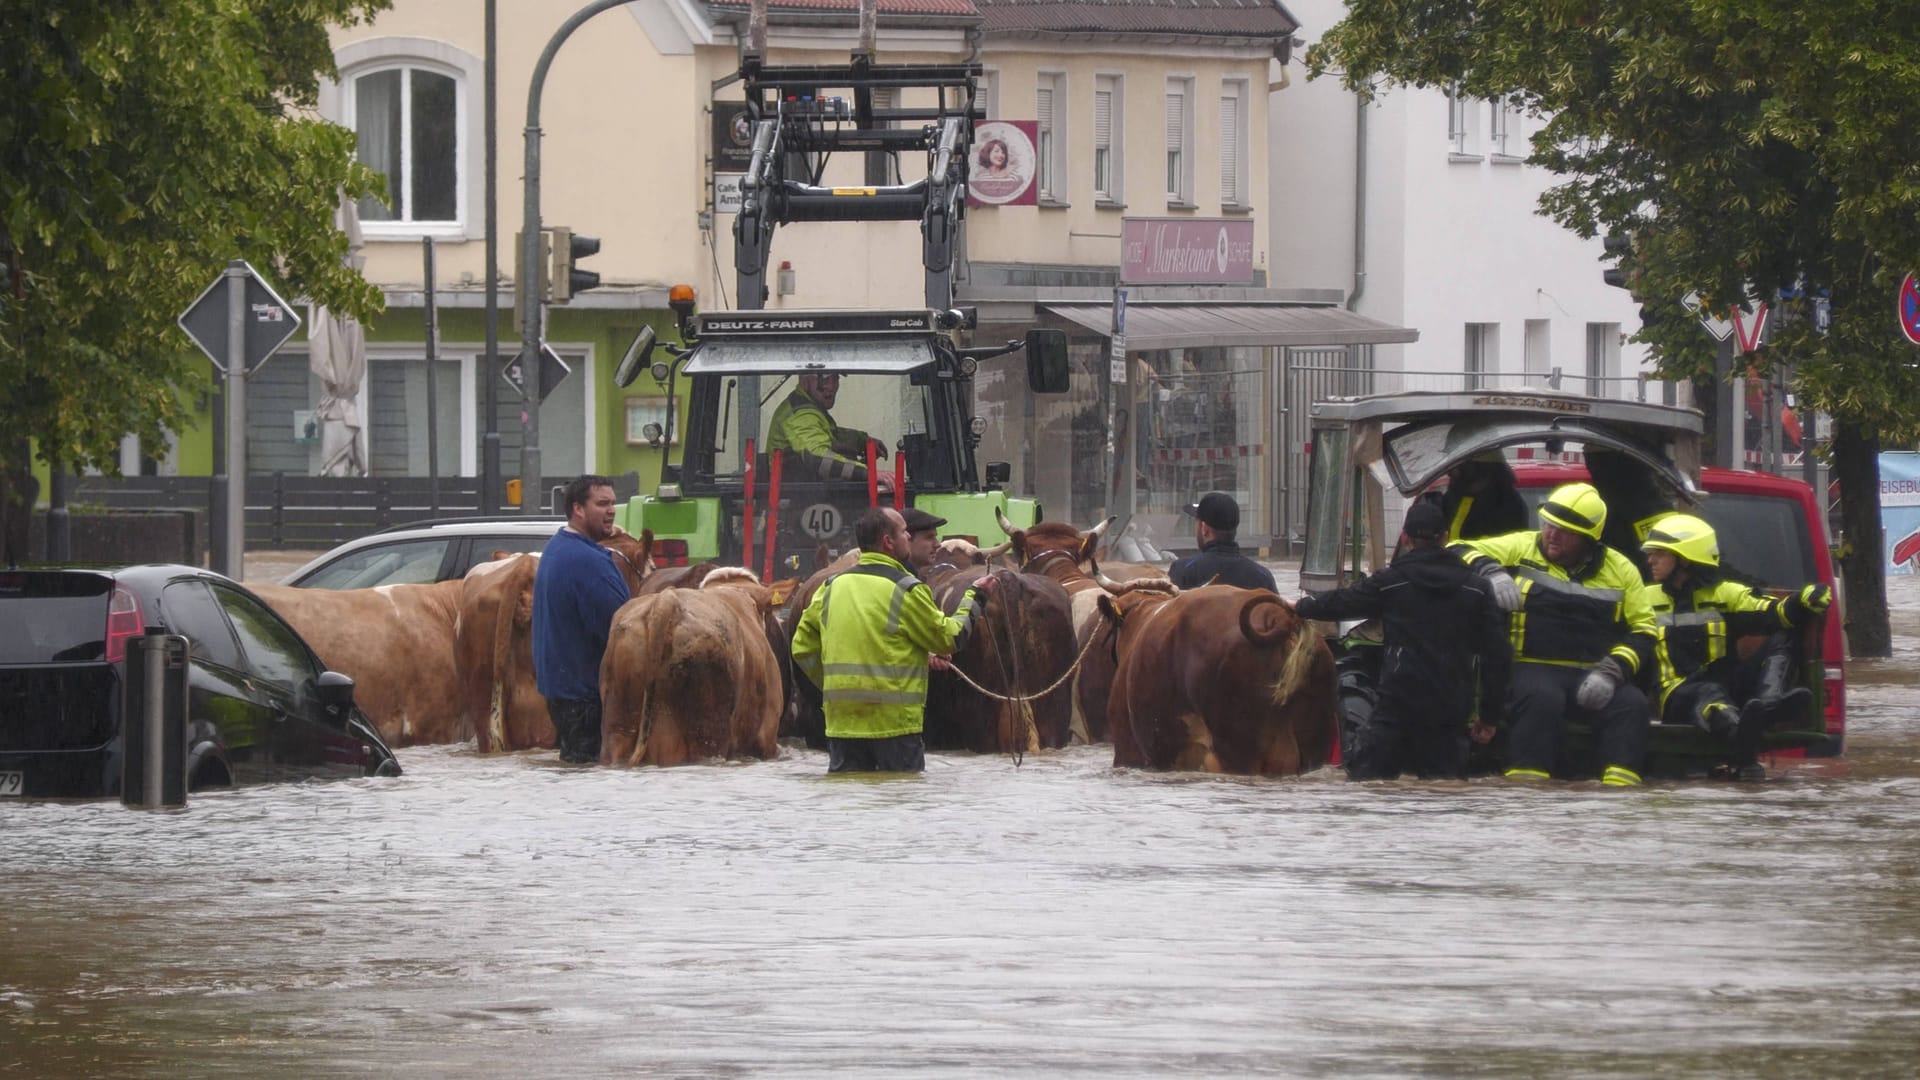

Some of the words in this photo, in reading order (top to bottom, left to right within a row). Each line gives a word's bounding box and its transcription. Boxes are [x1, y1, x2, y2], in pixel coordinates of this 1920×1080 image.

[717, 183, 737, 193] Cafe
[1144, 221, 1215, 273] Marksteiner
[890, 318, 924, 327] StarCab
[808, 509, 834, 533] 40
